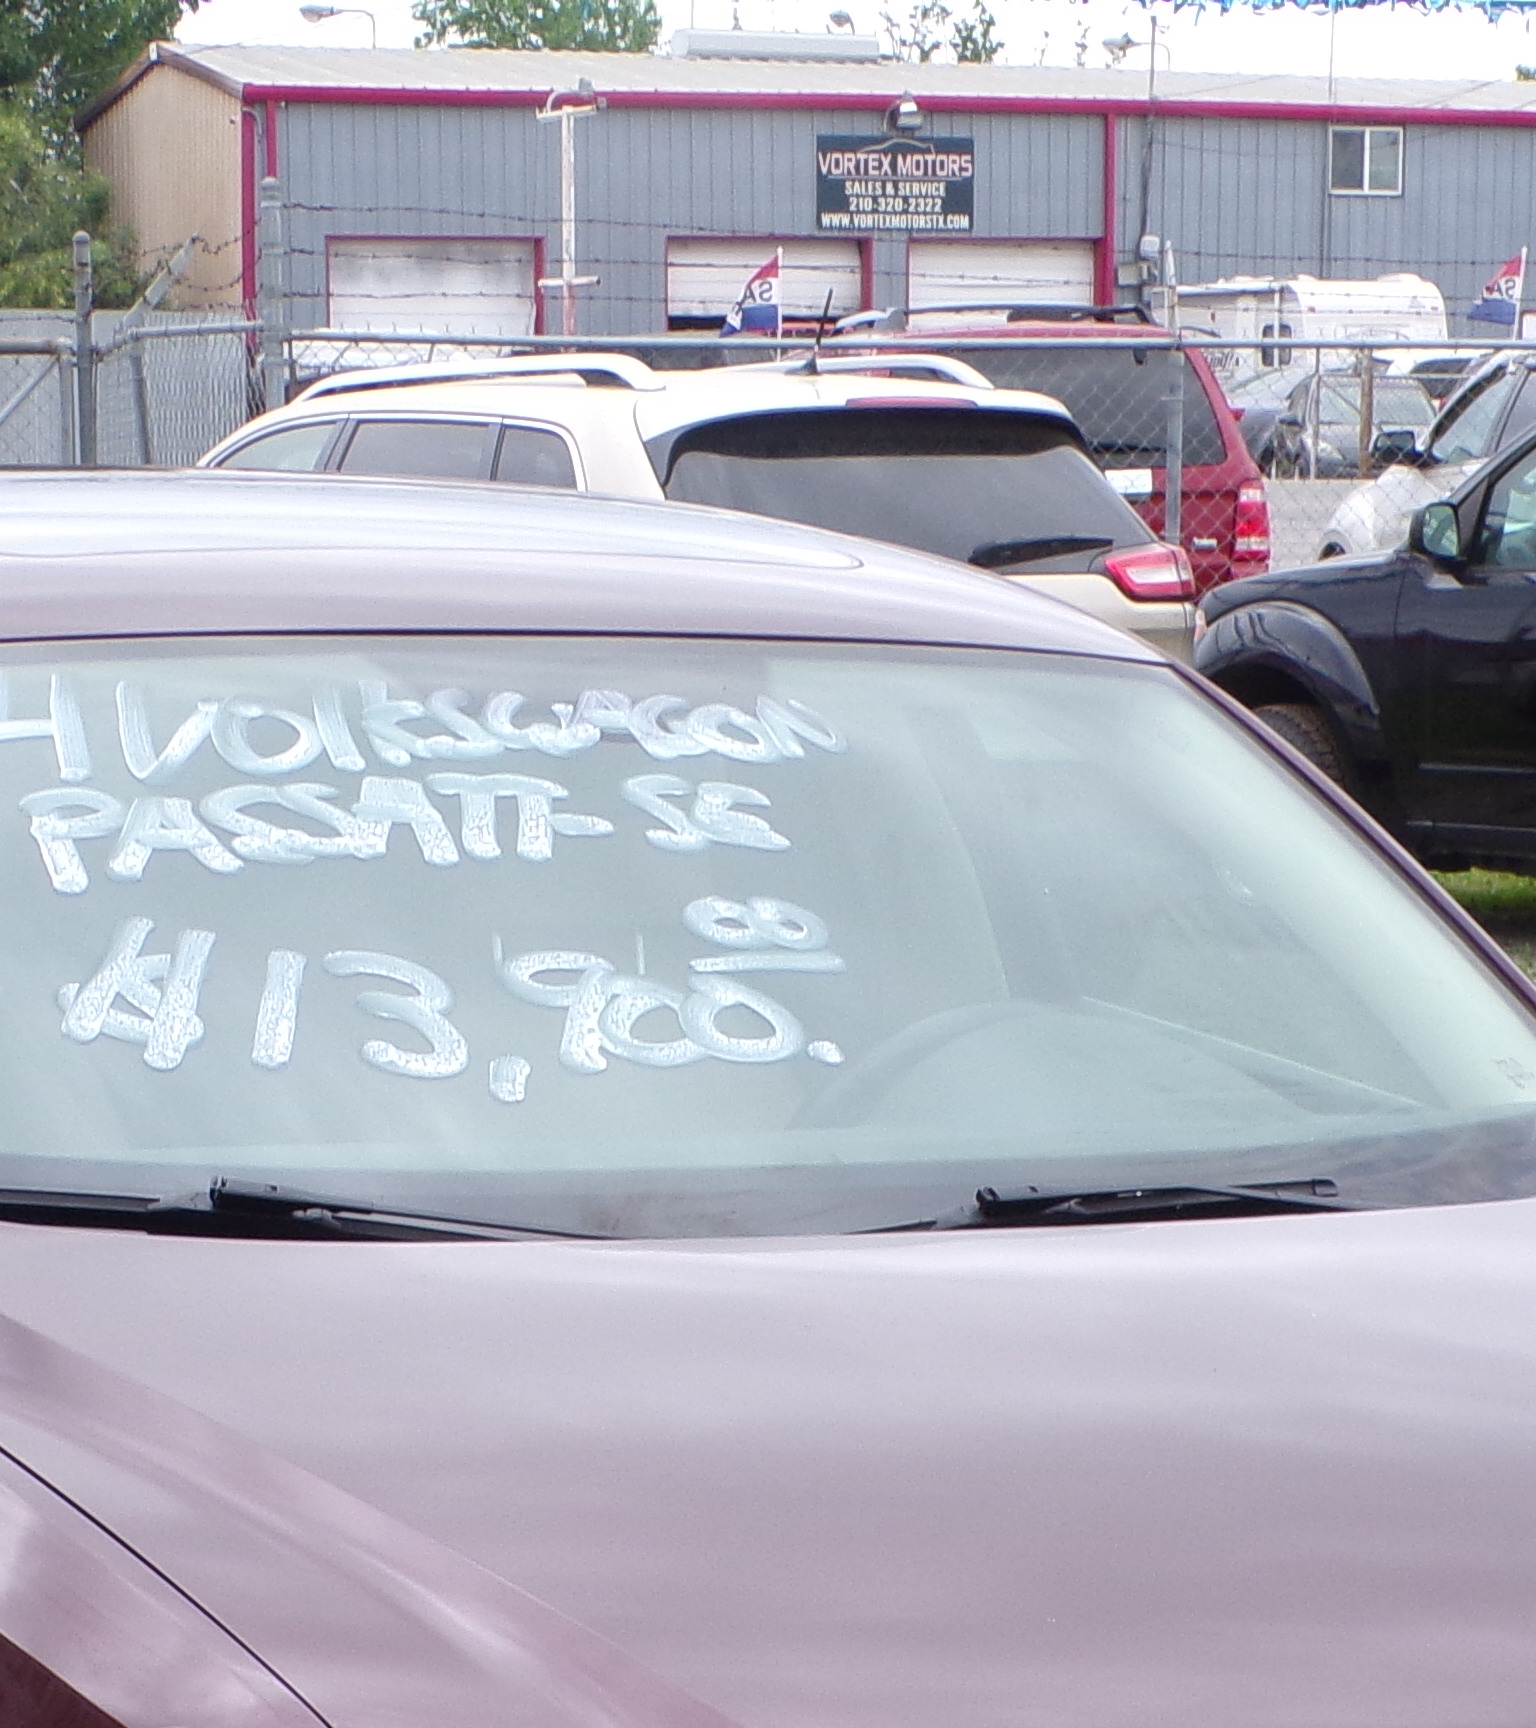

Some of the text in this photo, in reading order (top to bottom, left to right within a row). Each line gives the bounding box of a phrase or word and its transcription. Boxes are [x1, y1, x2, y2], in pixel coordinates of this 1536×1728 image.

[818, 152, 973, 177] VORTEX MOTORS
[844, 181, 946, 197] SALES & SERVICE
[820, 212, 970, 230] WWW.VORTEXMOTORSTX.COM
